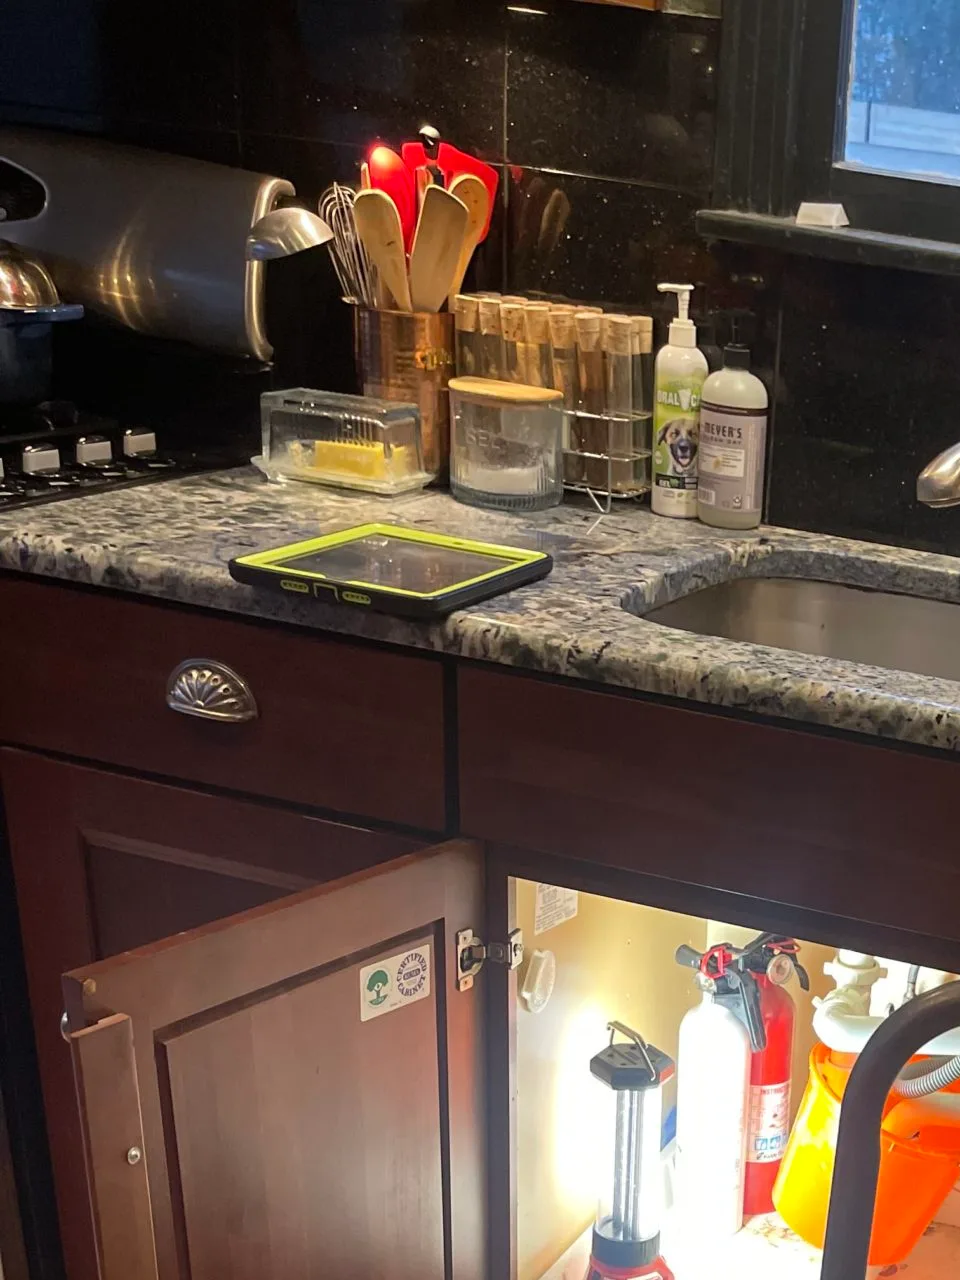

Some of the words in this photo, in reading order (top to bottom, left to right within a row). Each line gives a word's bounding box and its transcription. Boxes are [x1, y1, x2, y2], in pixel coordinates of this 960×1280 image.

[657, 390, 680, 406] ORAL
[396, 952, 428, 982] CERTIFIED
[397, 974, 426, 997] CABINET
